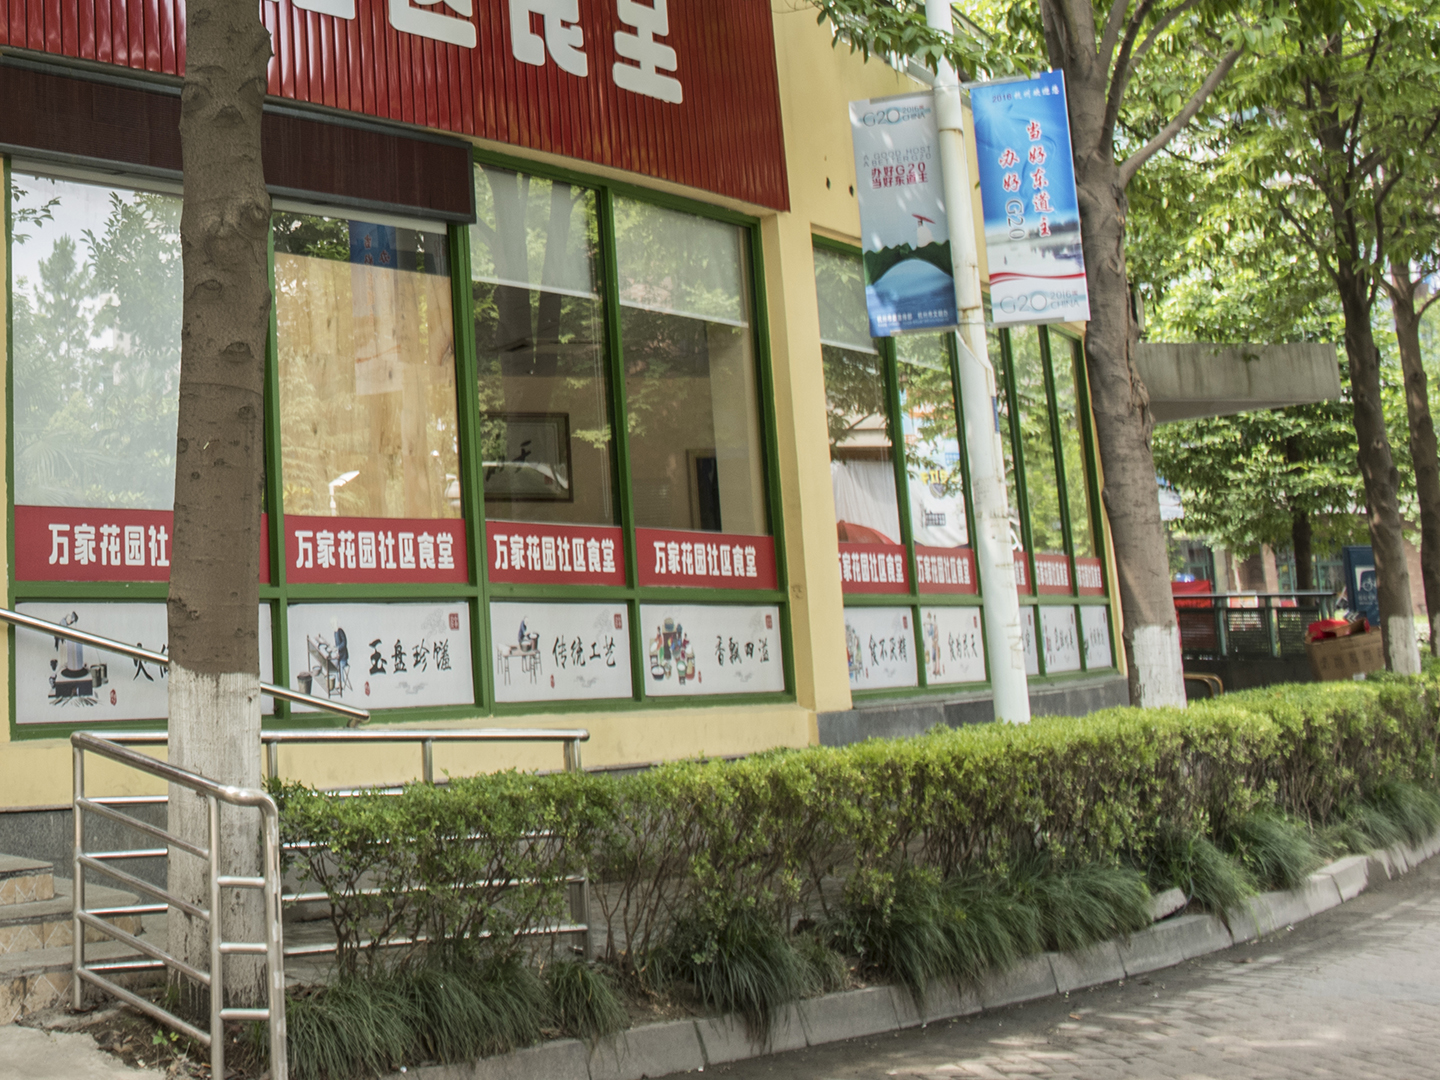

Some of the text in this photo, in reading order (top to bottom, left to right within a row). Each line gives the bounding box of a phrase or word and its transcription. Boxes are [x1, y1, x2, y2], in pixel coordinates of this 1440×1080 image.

[1026, 120, 1055, 237] 当好东道主
[294, 529, 456, 570] 万家花园社区食堂
[493, 533, 617, 573] 万家花园社区食堂
[653, 540, 758, 577] 万家花园社区食堂
[916, 554, 971, 584] 万家花园社区食堂
[552, 634, 617, 670] 传统工艺
